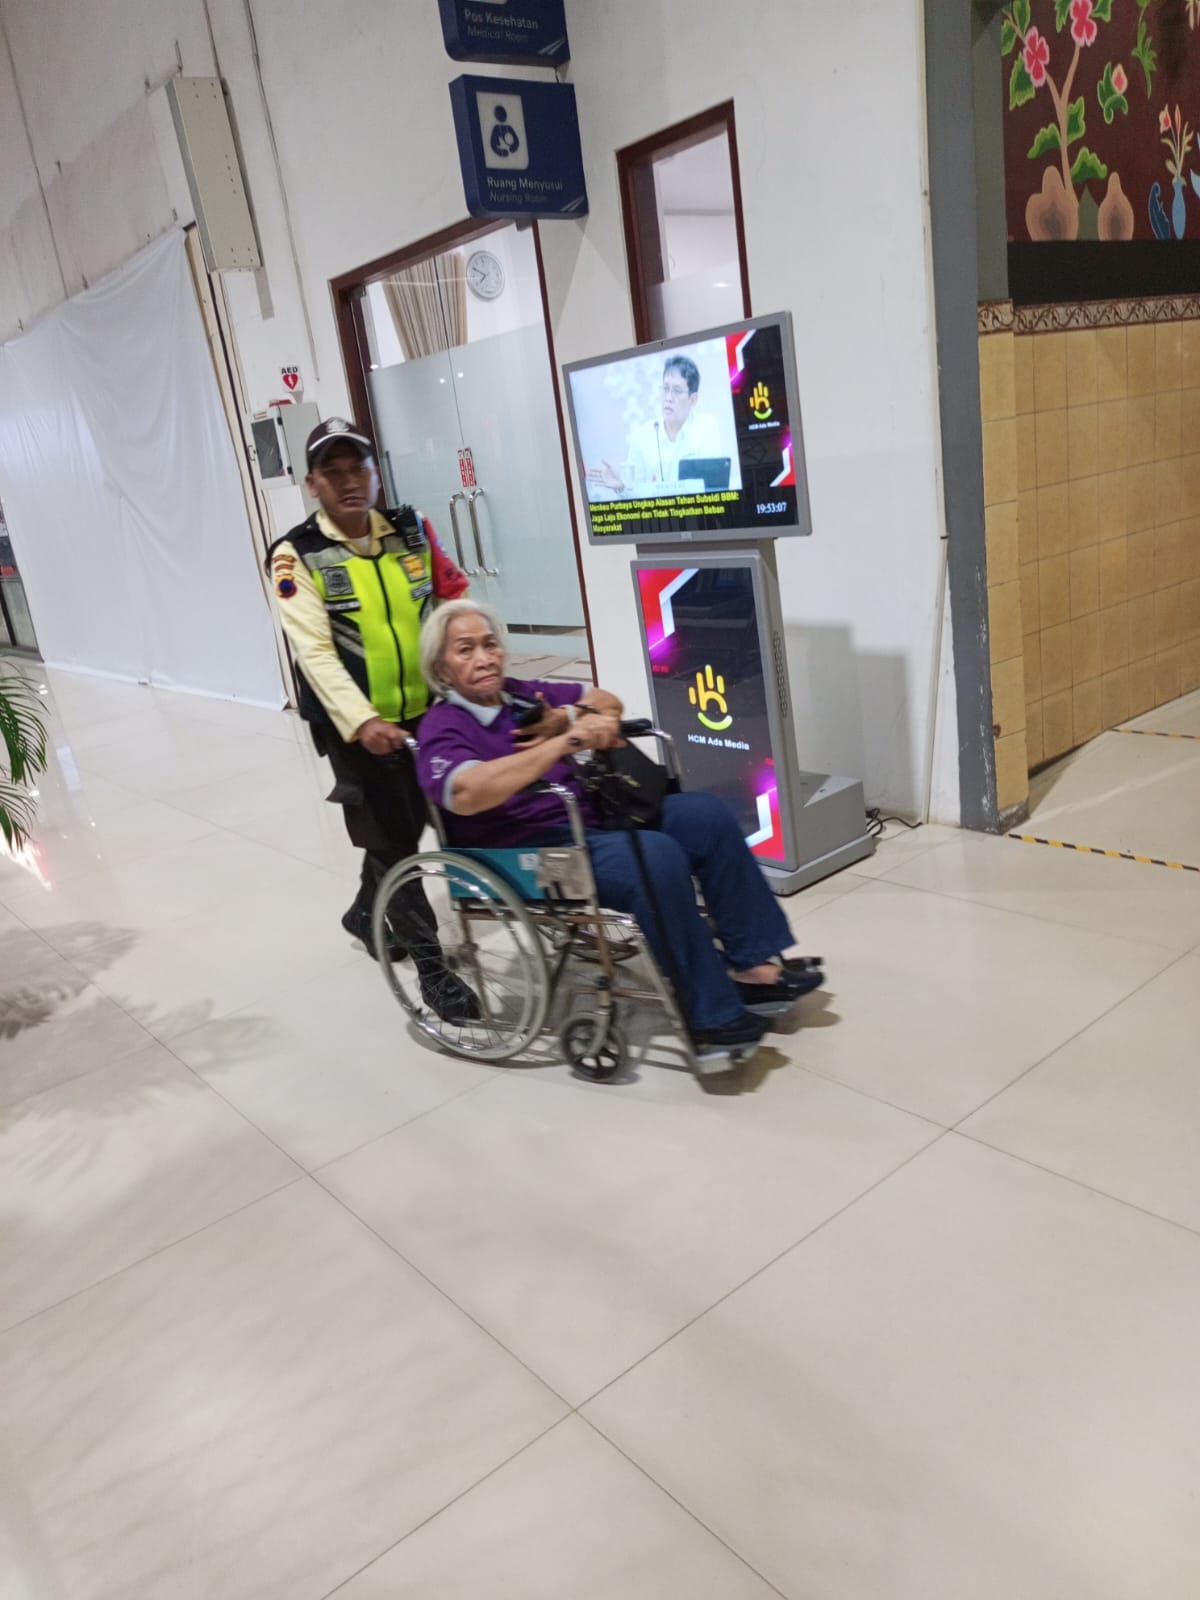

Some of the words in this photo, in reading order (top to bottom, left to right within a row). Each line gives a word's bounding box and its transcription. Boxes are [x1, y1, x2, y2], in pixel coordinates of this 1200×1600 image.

[464, 7, 483, 22] Pos
[485, 12, 538, 29] Kesehatan
[487, 176, 517, 190] Ruang
[281, 366, 298, 374] AED
[655, 498, 675, 506] Alasan
[676, 496, 695, 505] Tahan
[695, 494, 720, 504] Subsidi
[616, 512, 640, 520] Ekonomi
[641, 510, 652, 519] dan
[653, 509, 669, 518] Tidak
[669, 507, 703, 518] Tingkatkan
[704, 505, 725, 514] Beban
[756, 502, 787, 514] 19:53:07
[688, 734, 706, 744] HCM
[707, 737, 723, 746] Ads
[724, 739, 750, 750] Media
